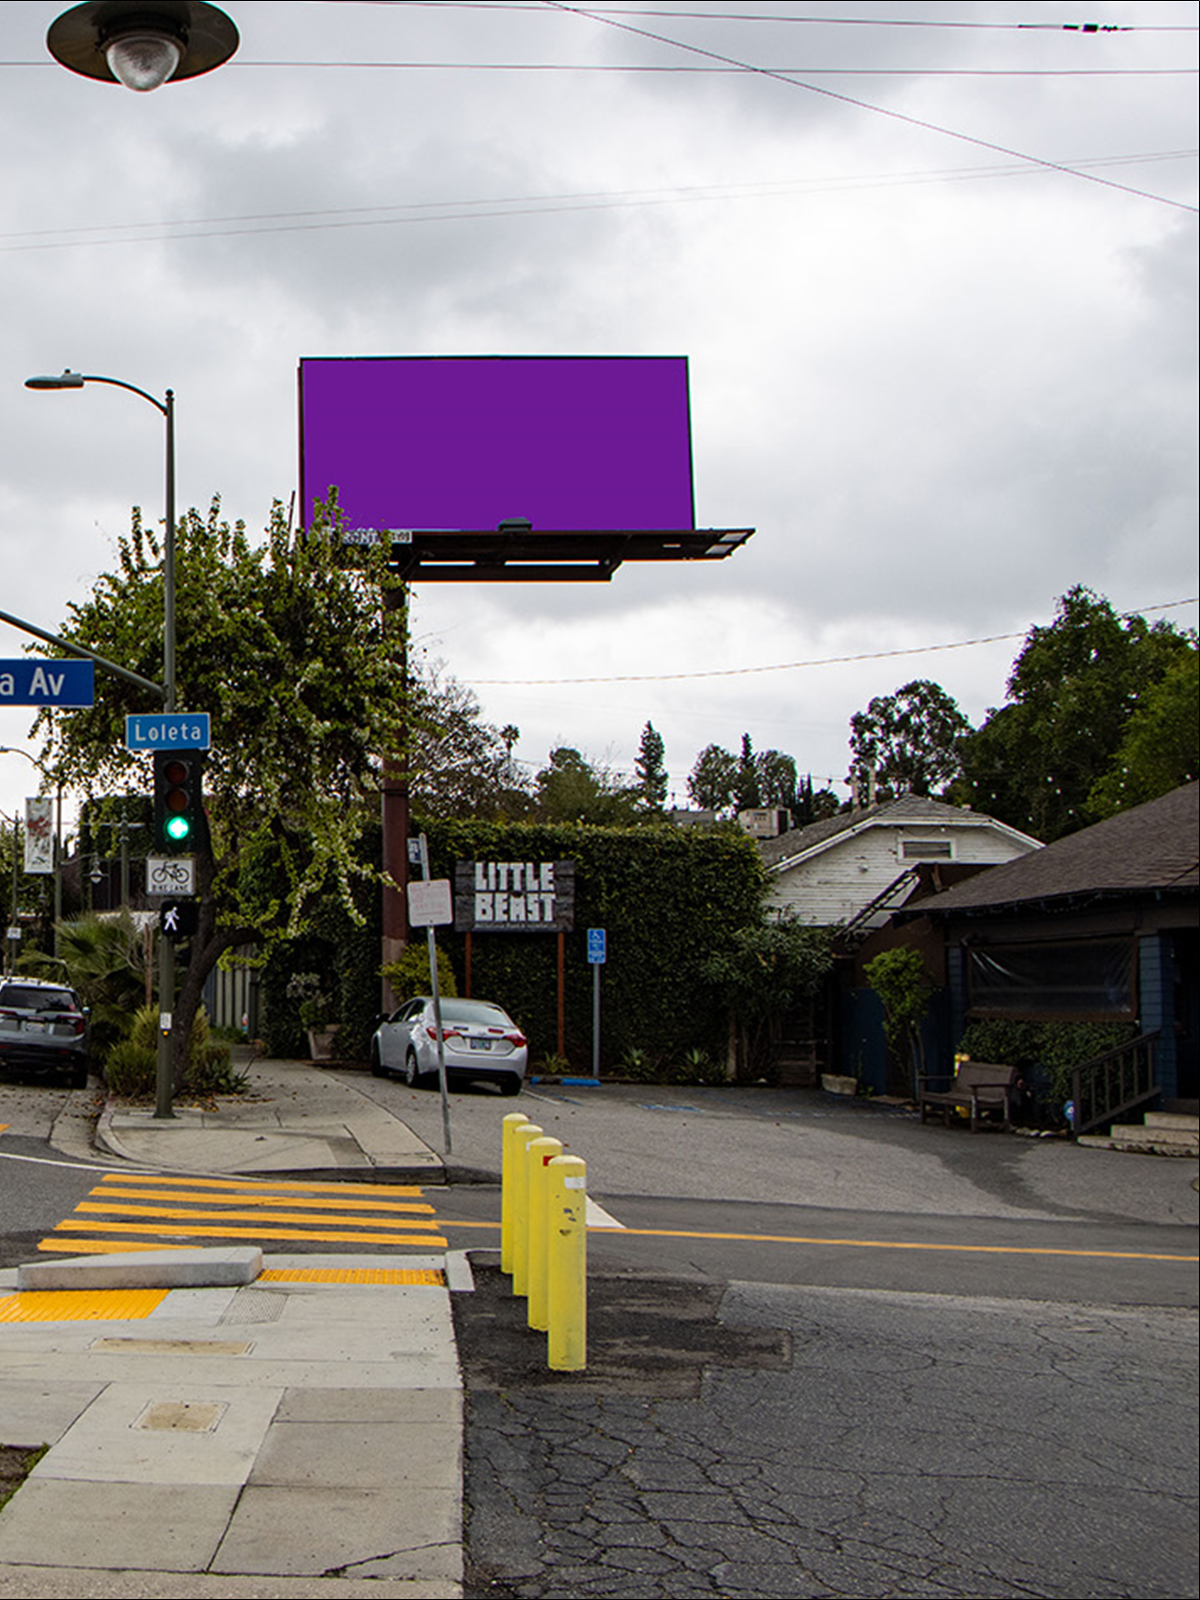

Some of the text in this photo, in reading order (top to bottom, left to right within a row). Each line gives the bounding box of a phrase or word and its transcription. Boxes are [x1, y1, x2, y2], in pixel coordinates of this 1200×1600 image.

[28, 666, 65, 696] Av
[135, 723, 201, 741] Loleta
[152, 884, 188, 892] BIKE LANE
[475, 862, 554, 891] LITTLE
[475, 892, 556, 921] BEAST
